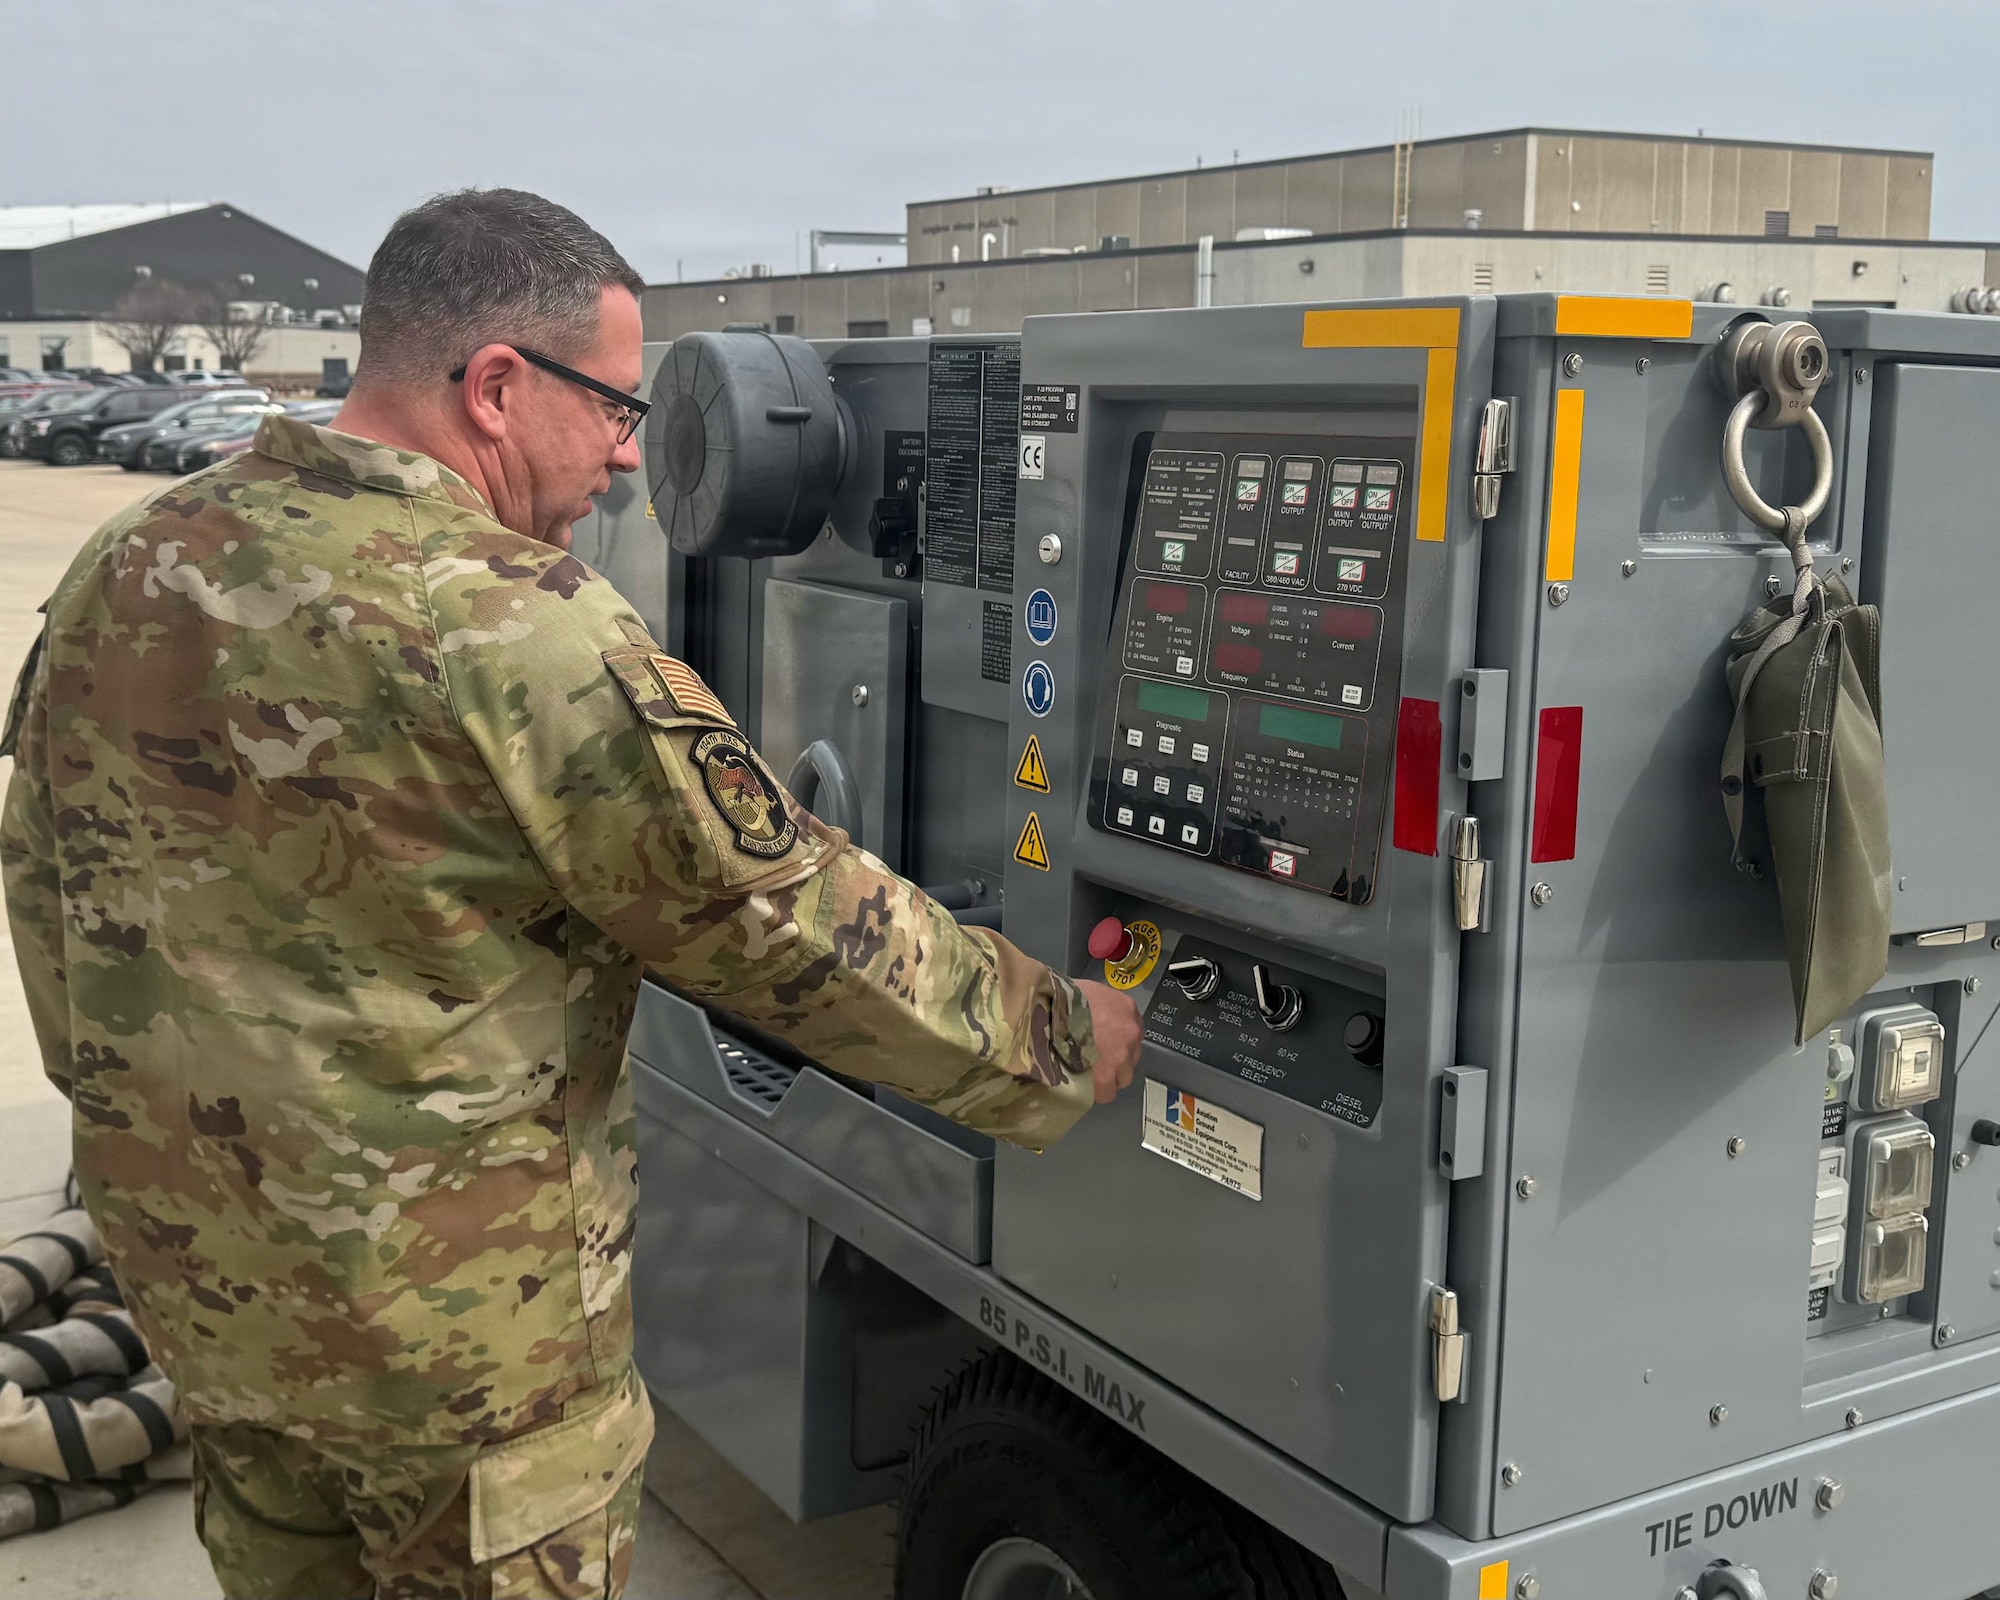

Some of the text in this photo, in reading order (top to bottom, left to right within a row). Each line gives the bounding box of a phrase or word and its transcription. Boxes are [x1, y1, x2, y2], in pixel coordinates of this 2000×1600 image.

[1239, 482, 1248, 490] ON
[1286, 485, 1295, 493] ON
[1334, 488, 1344, 496] ON
[1245, 492, 1257, 500] OFF
[1292, 495, 1304, 503] OFF
[1368, 491, 1378, 499] ON
[1237, 503, 1255, 511] INPUT
[1341, 498, 1354, 506] OFF
[1375, 500, 1388, 508] OFF
[1281, 506, 1305, 515] OUTPUT
[1334, 510, 1350, 519] MAIN
[1328, 518, 1354, 528] OUTPUT
[1359, 512, 1393, 522] AUXILIARY
[1361, 521, 1389, 531] OUTPUT
[1162, 563, 1182, 573] ENGINE
[1225, 570, 1250, 580] FACILITY
[1291, 577, 1305, 587] VAC
[1336, 583, 1363, 593] 270 VDC
[1156, 613, 1174, 624] Engine
[1174, 626, 1193, 634] BATTERY
[1230, 625, 1251, 637] Voltage
[1331, 640, 1355, 651] Current
[1221, 671, 1249, 684] Frequency
[1155, 720, 1182, 733] Diagnostic
[1286, 747, 1305, 759] Status
[1235, 761, 1246, 770] FUEL
[1226, 806, 1240, 815] FILTER
[1110, 970, 1136, 985] STOP
[1162, 979, 1176, 989] OFF
[1227, 990, 1256, 1007] OUTPUT
[1158, 1003, 1179, 1016] INPUT
[1241, 1006, 1257, 1020] VAC
[1151, 1012, 1174, 1026] DIESEL
[1193, 1016, 1215, 1029] INPUT
[1218, 1011, 1244, 1027] DIESEL
[1184, 1024, 1215, 1041] FACILITY
[1144, 1030, 1202, 1058] OPERATING MODE
[1238, 1033, 1260, 1047] 50 HZ
[1277, 1047, 1299, 1062] 60 HZ
[1231, 1053, 1288, 1080] AC FREQUENCY
[1240, 1068, 1269, 1084] SELECT
[1335, 1092, 1363, 1111] DIESEL
[1196, 1108, 1218, 1123] Aviation
[1320, 1100, 1371, 1124] START/STOP
[1195, 1118, 1216, 1132] Ground
[1195, 1128, 1224, 1147] Equipment
[1223, 1141, 1239, 1154] Corp.
[1160, 1146, 1180, 1160] SALES
[1187, 1158, 1213, 1175] SERVICE
[1220, 1175, 1242, 1190] PARTS
[979, 1296, 1146, 1431] 85 P.S.I. MAX
[1645, 1476, 1799, 1557] TIE DOWN
